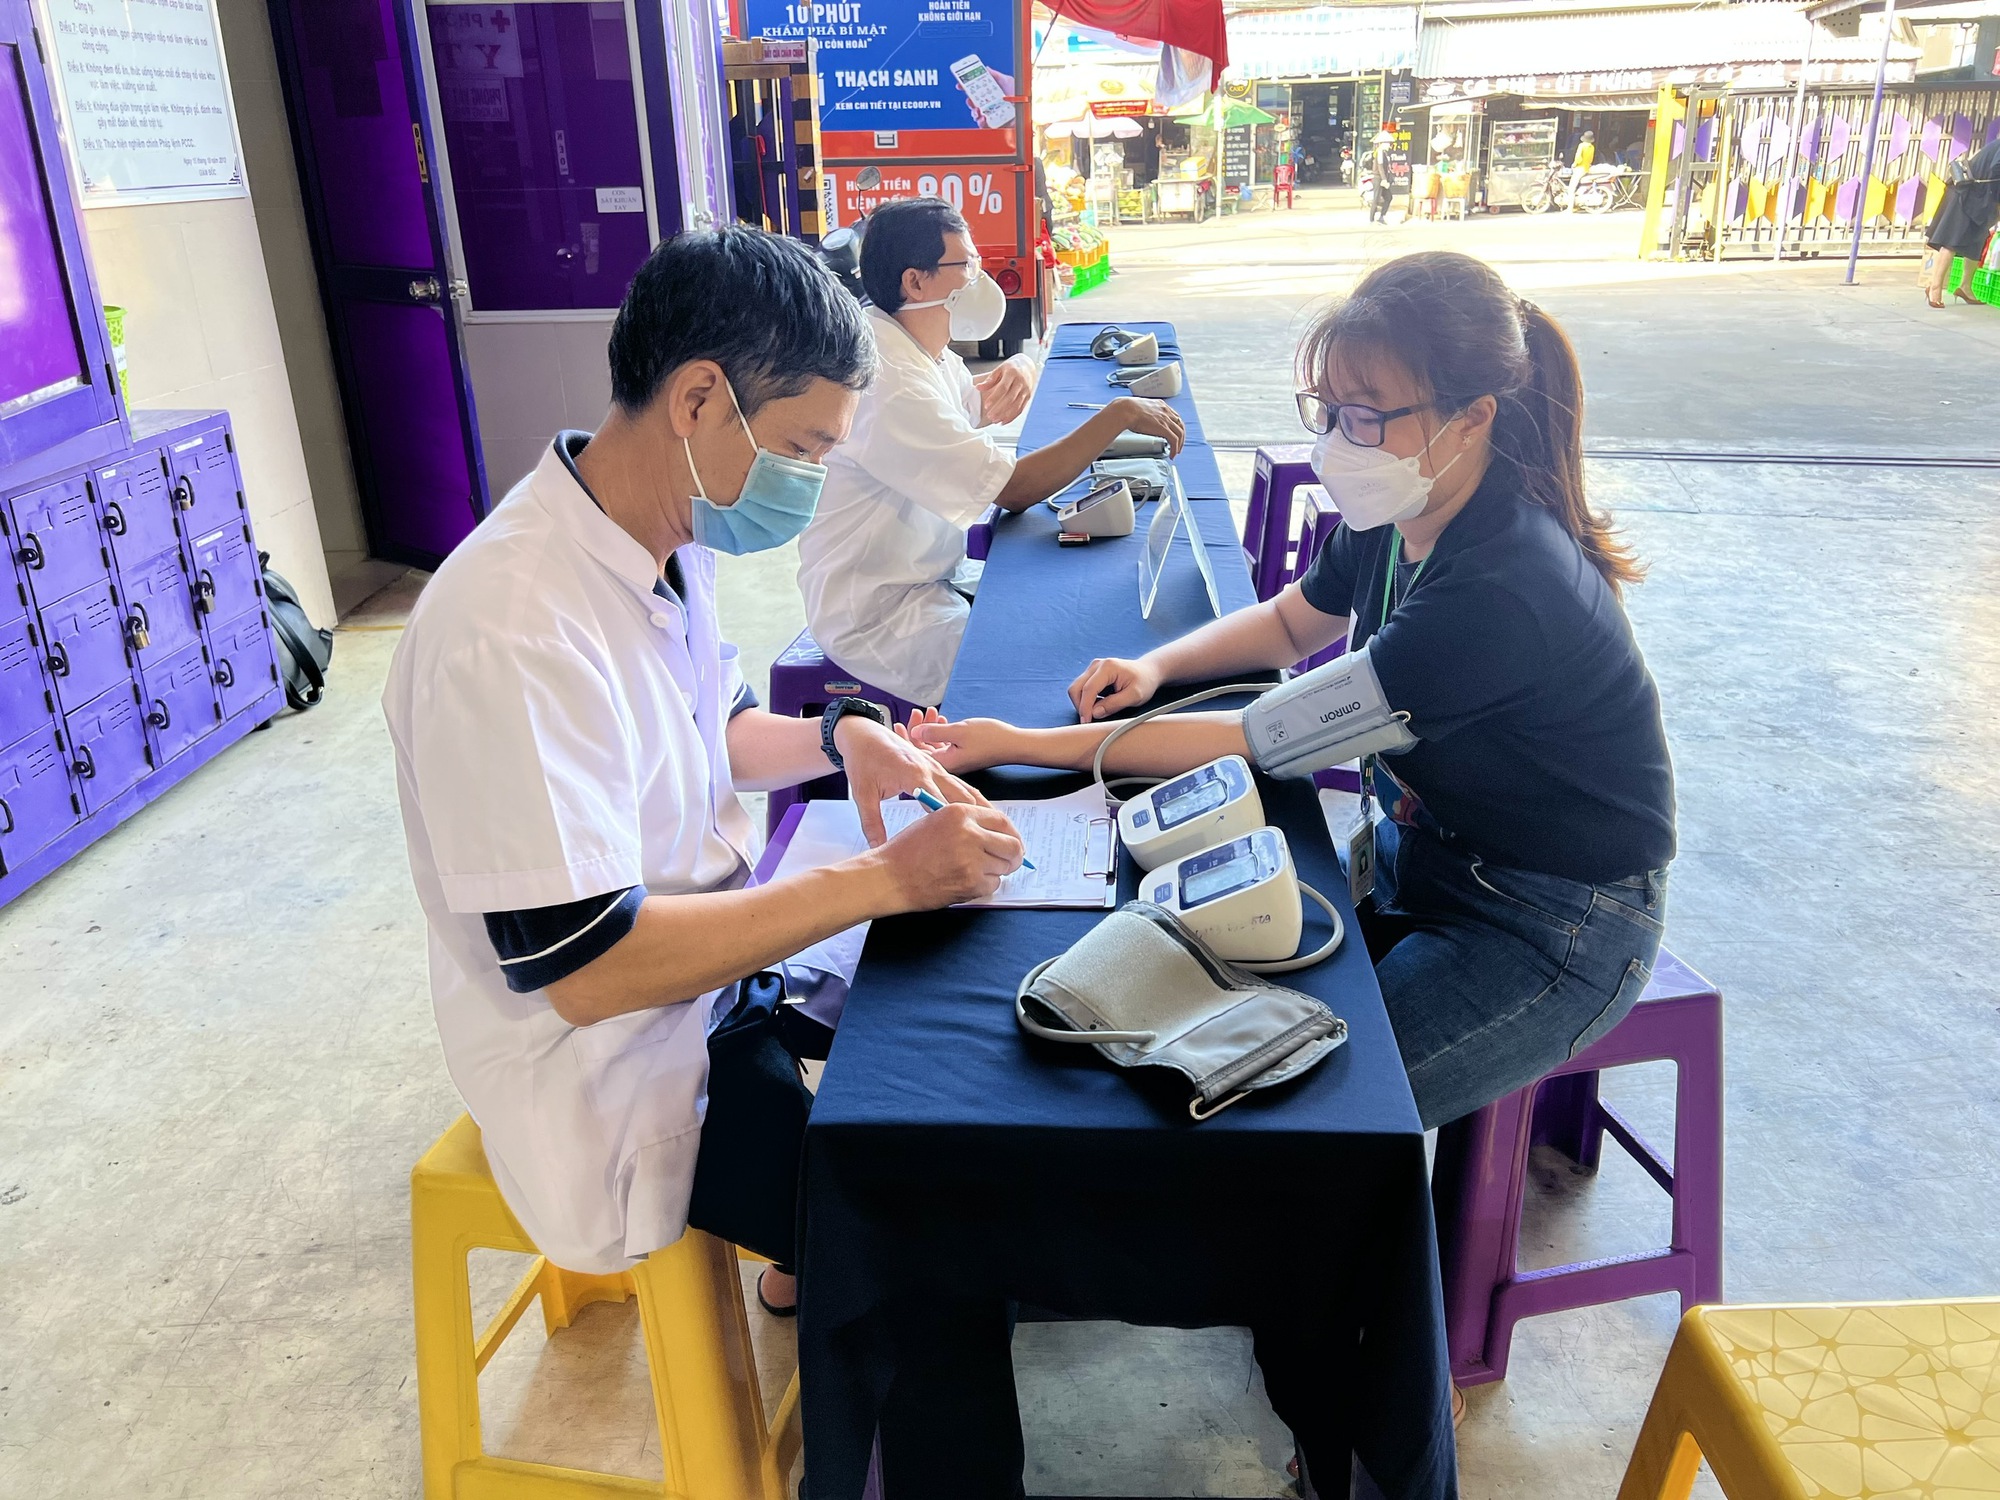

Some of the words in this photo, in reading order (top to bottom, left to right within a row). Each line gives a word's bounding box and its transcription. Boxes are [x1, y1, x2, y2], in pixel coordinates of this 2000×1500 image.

[786, 4, 808, 24] 10
[813, 0, 861, 24] PHÚT
[918, 11, 946, 22] KHÔNG
[947, 11, 963, 21] GIỚI
[964, 12, 981, 22] HẠN
[763, 25, 804, 36] KHÁM
[808, 24, 834, 36] PHÁ
[840, 24, 853, 35] BÍ
[857, 24, 887, 37] MẬT
[825, 39, 844, 49] CÒN
[835, 70, 889, 91] THẠCH
[893, 70, 938, 86] SANH
[835, 102, 853, 110] XEM
[872, 100, 887, 109] TIẾT
[888, 101, 901, 111] TẠI
[902, 101, 941, 109] ECOOP.VN
[883, 177, 911, 190] TIỀN
